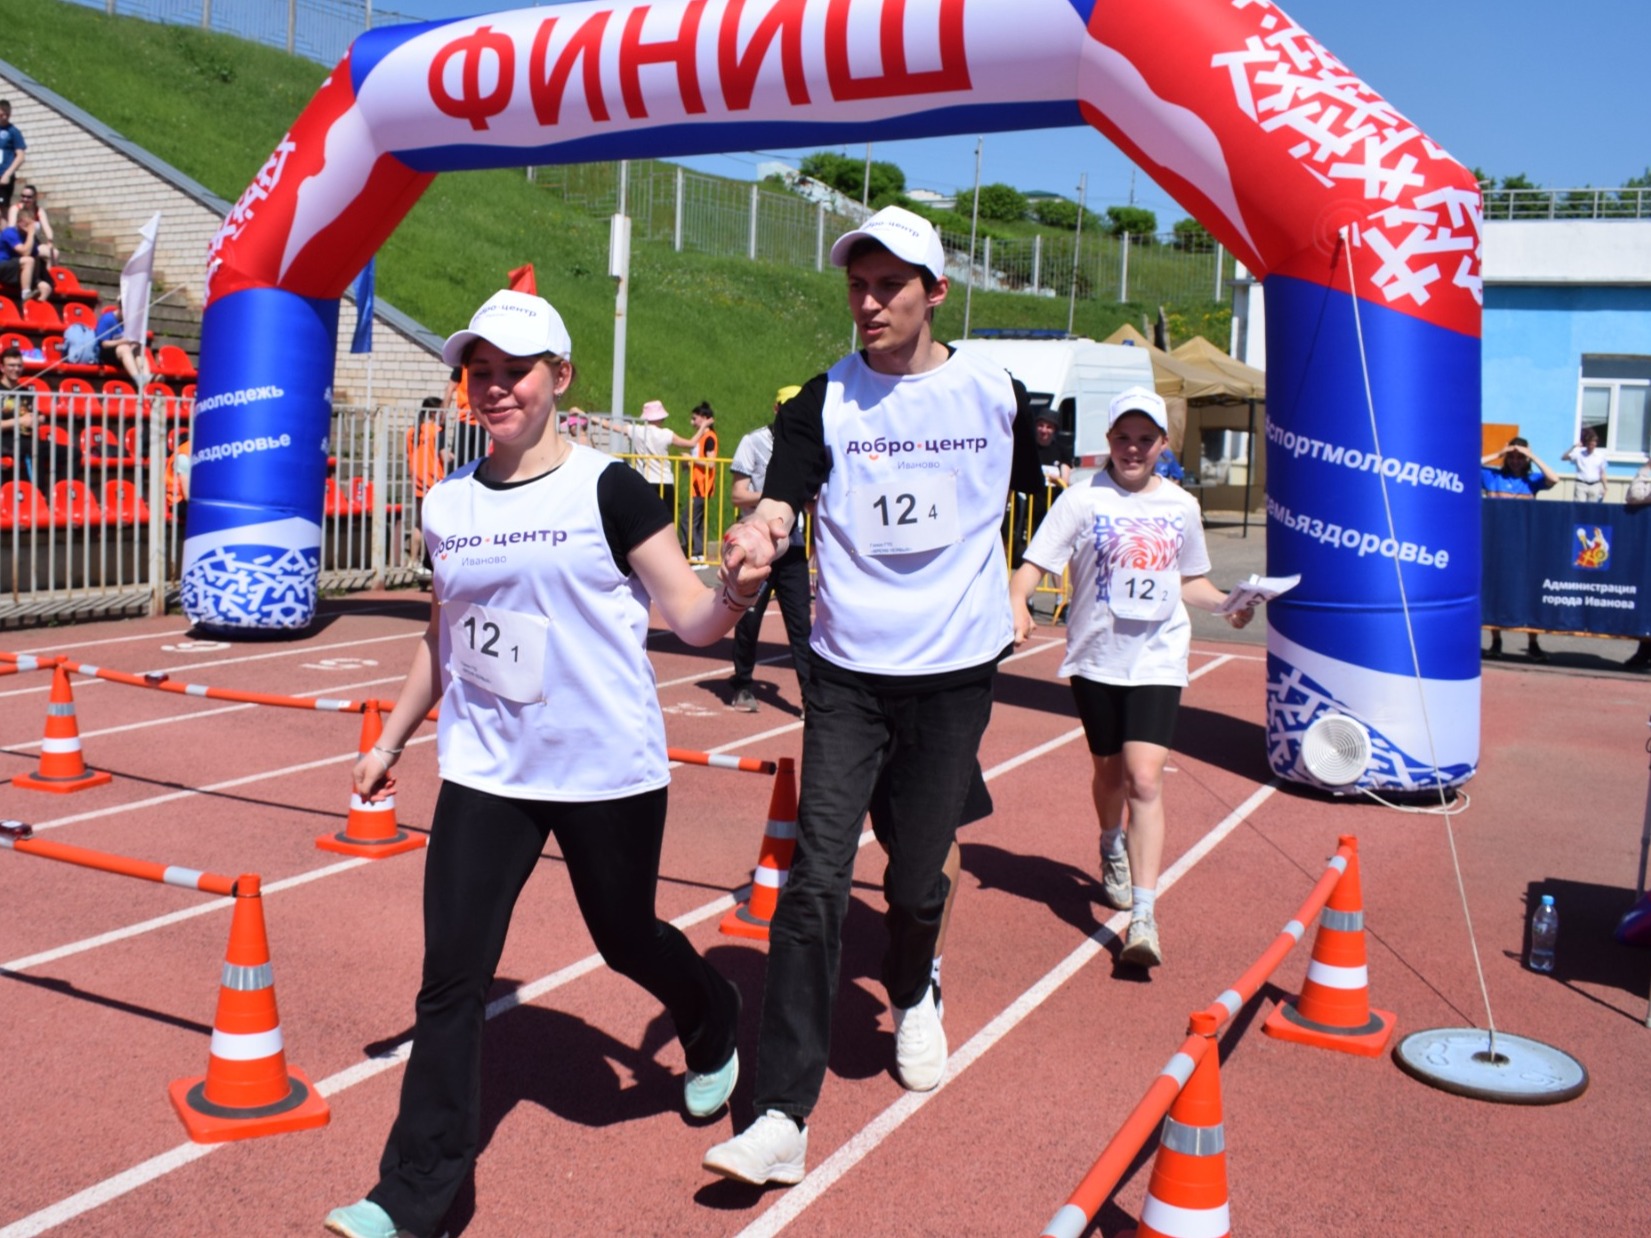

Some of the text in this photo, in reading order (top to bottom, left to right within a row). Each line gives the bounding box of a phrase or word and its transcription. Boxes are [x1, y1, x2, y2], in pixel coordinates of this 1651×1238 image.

[427, 0, 973, 131] ФИНИШ
[897, 461, 940, 470] Иваново
[872, 493, 938, 526] 12 4
[461, 555, 507, 566] Иваново
[1124, 577, 1156, 600] 12
[1542, 578, 1637, 595] Администрация
[1542, 595, 1635, 610] города Иванова
[463, 616, 519, 663] 12 1
